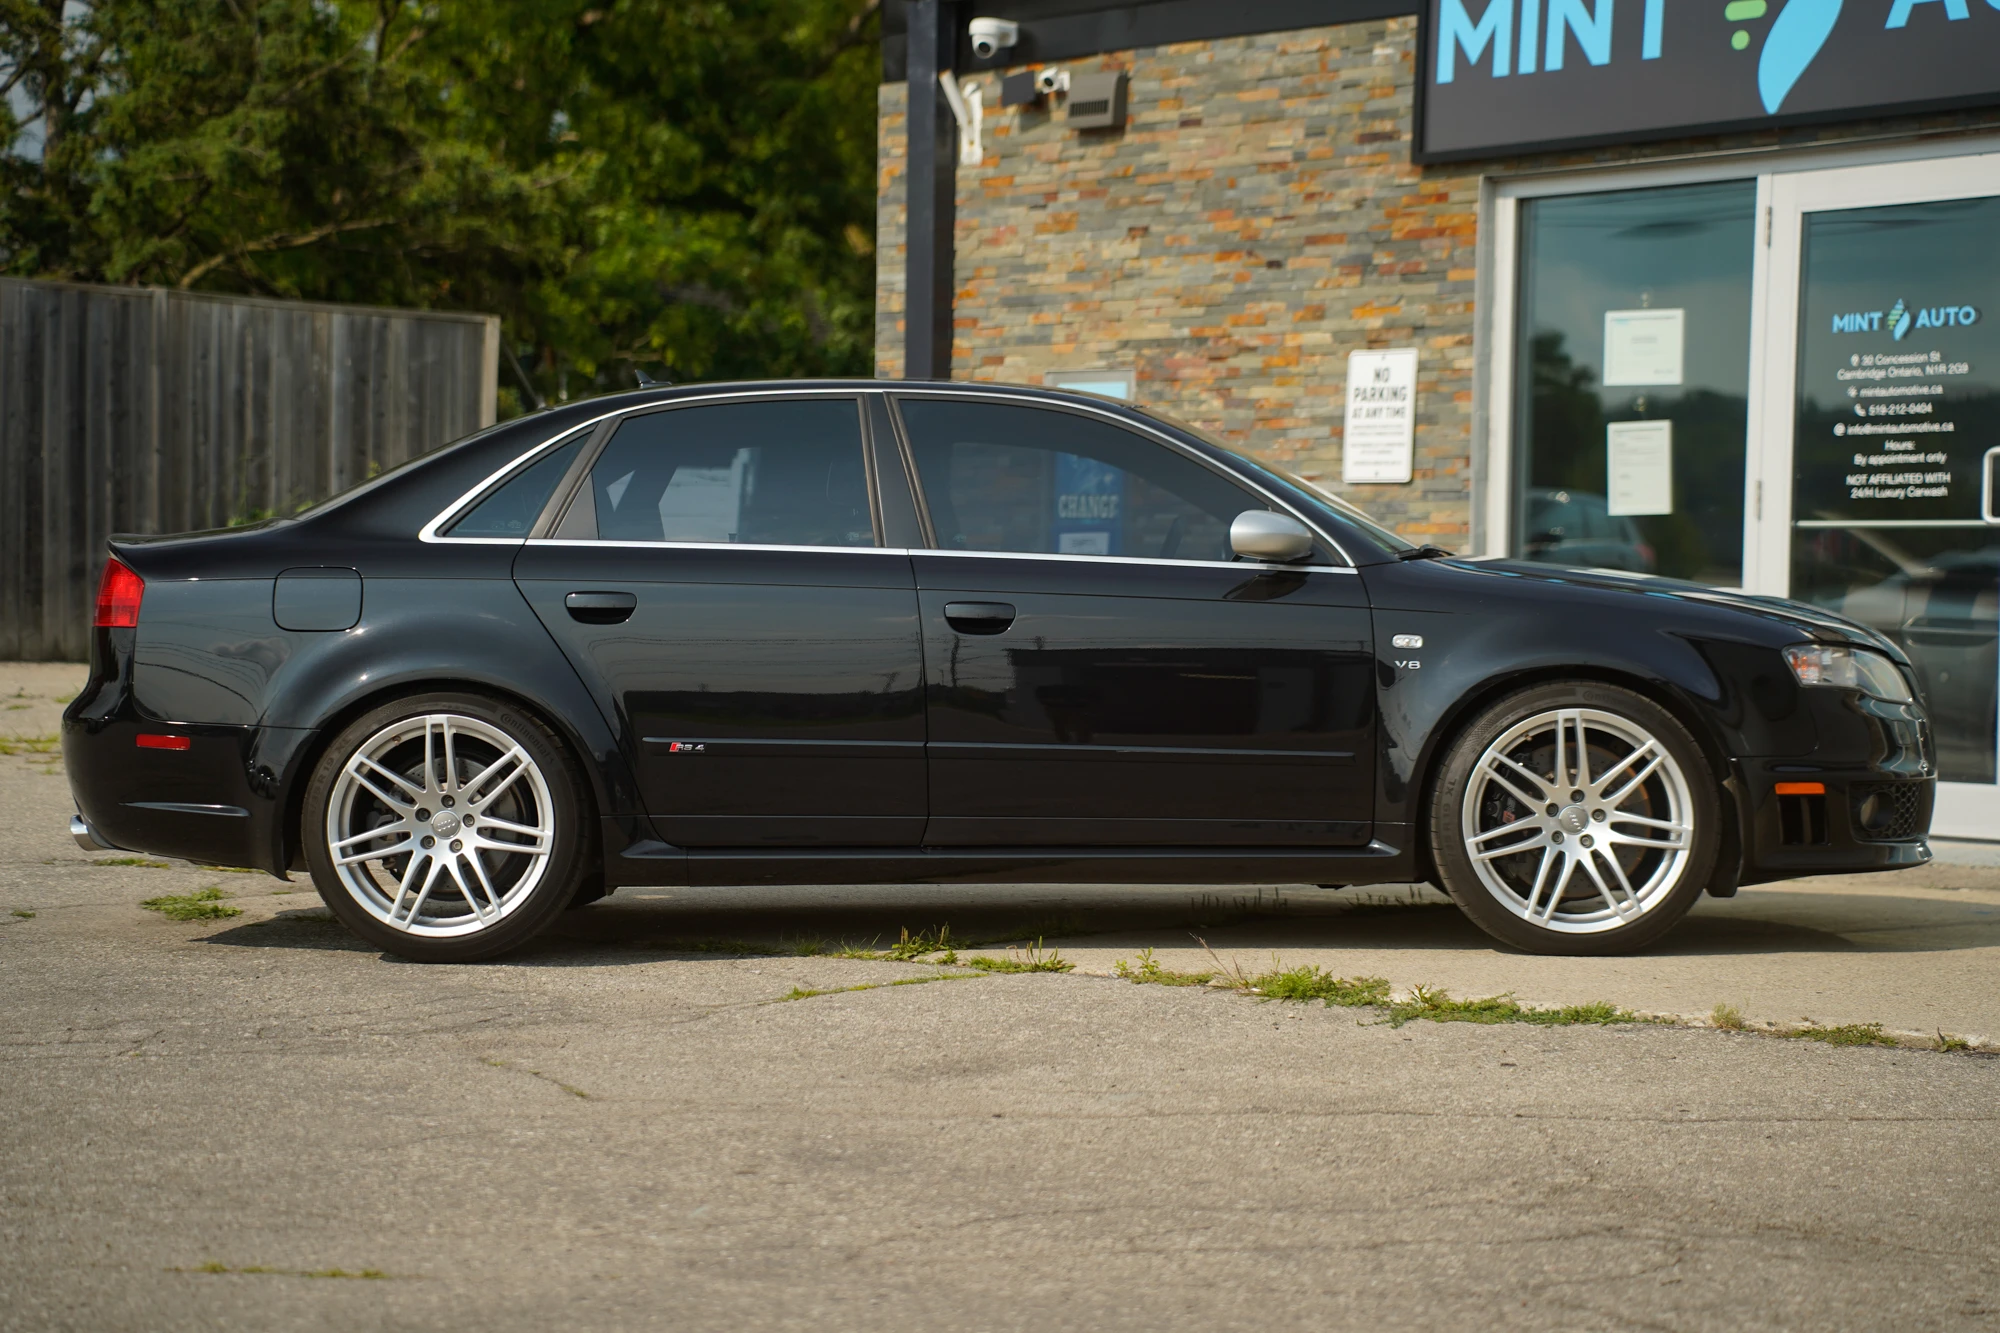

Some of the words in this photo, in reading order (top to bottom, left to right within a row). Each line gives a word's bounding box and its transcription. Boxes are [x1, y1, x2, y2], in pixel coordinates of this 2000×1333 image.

[1832, 312, 1883, 333] MINT
[1914, 305, 1976, 328] AUTO
[1875, 353, 1928, 365] Concession
[1929, 350, 1941, 362] St
[1373, 366, 1391, 383] NO
[1836, 367, 1887, 380] Cambridge
[1353, 386, 1408, 402] PARKING
[1352, 407, 1363, 419] AT
[1365, 407, 1383, 419] ANY
[1385, 406, 1406, 419] TIME
[1884, 439, 1916, 451] Hours:
[1853, 453, 1867, 467] By
[1867, 452, 1925, 466] appointment
[1925, 451, 1947, 464] only
[1846, 473, 1868, 486] NOT
[1868, 472, 1924, 485] AFFILIATED
[1923, 471, 1951, 484] WITH
[1874, 486, 1906, 500] Luxury
[1906, 485, 1948, 498] Carwash
[1394, 660, 1421, 670] V8
